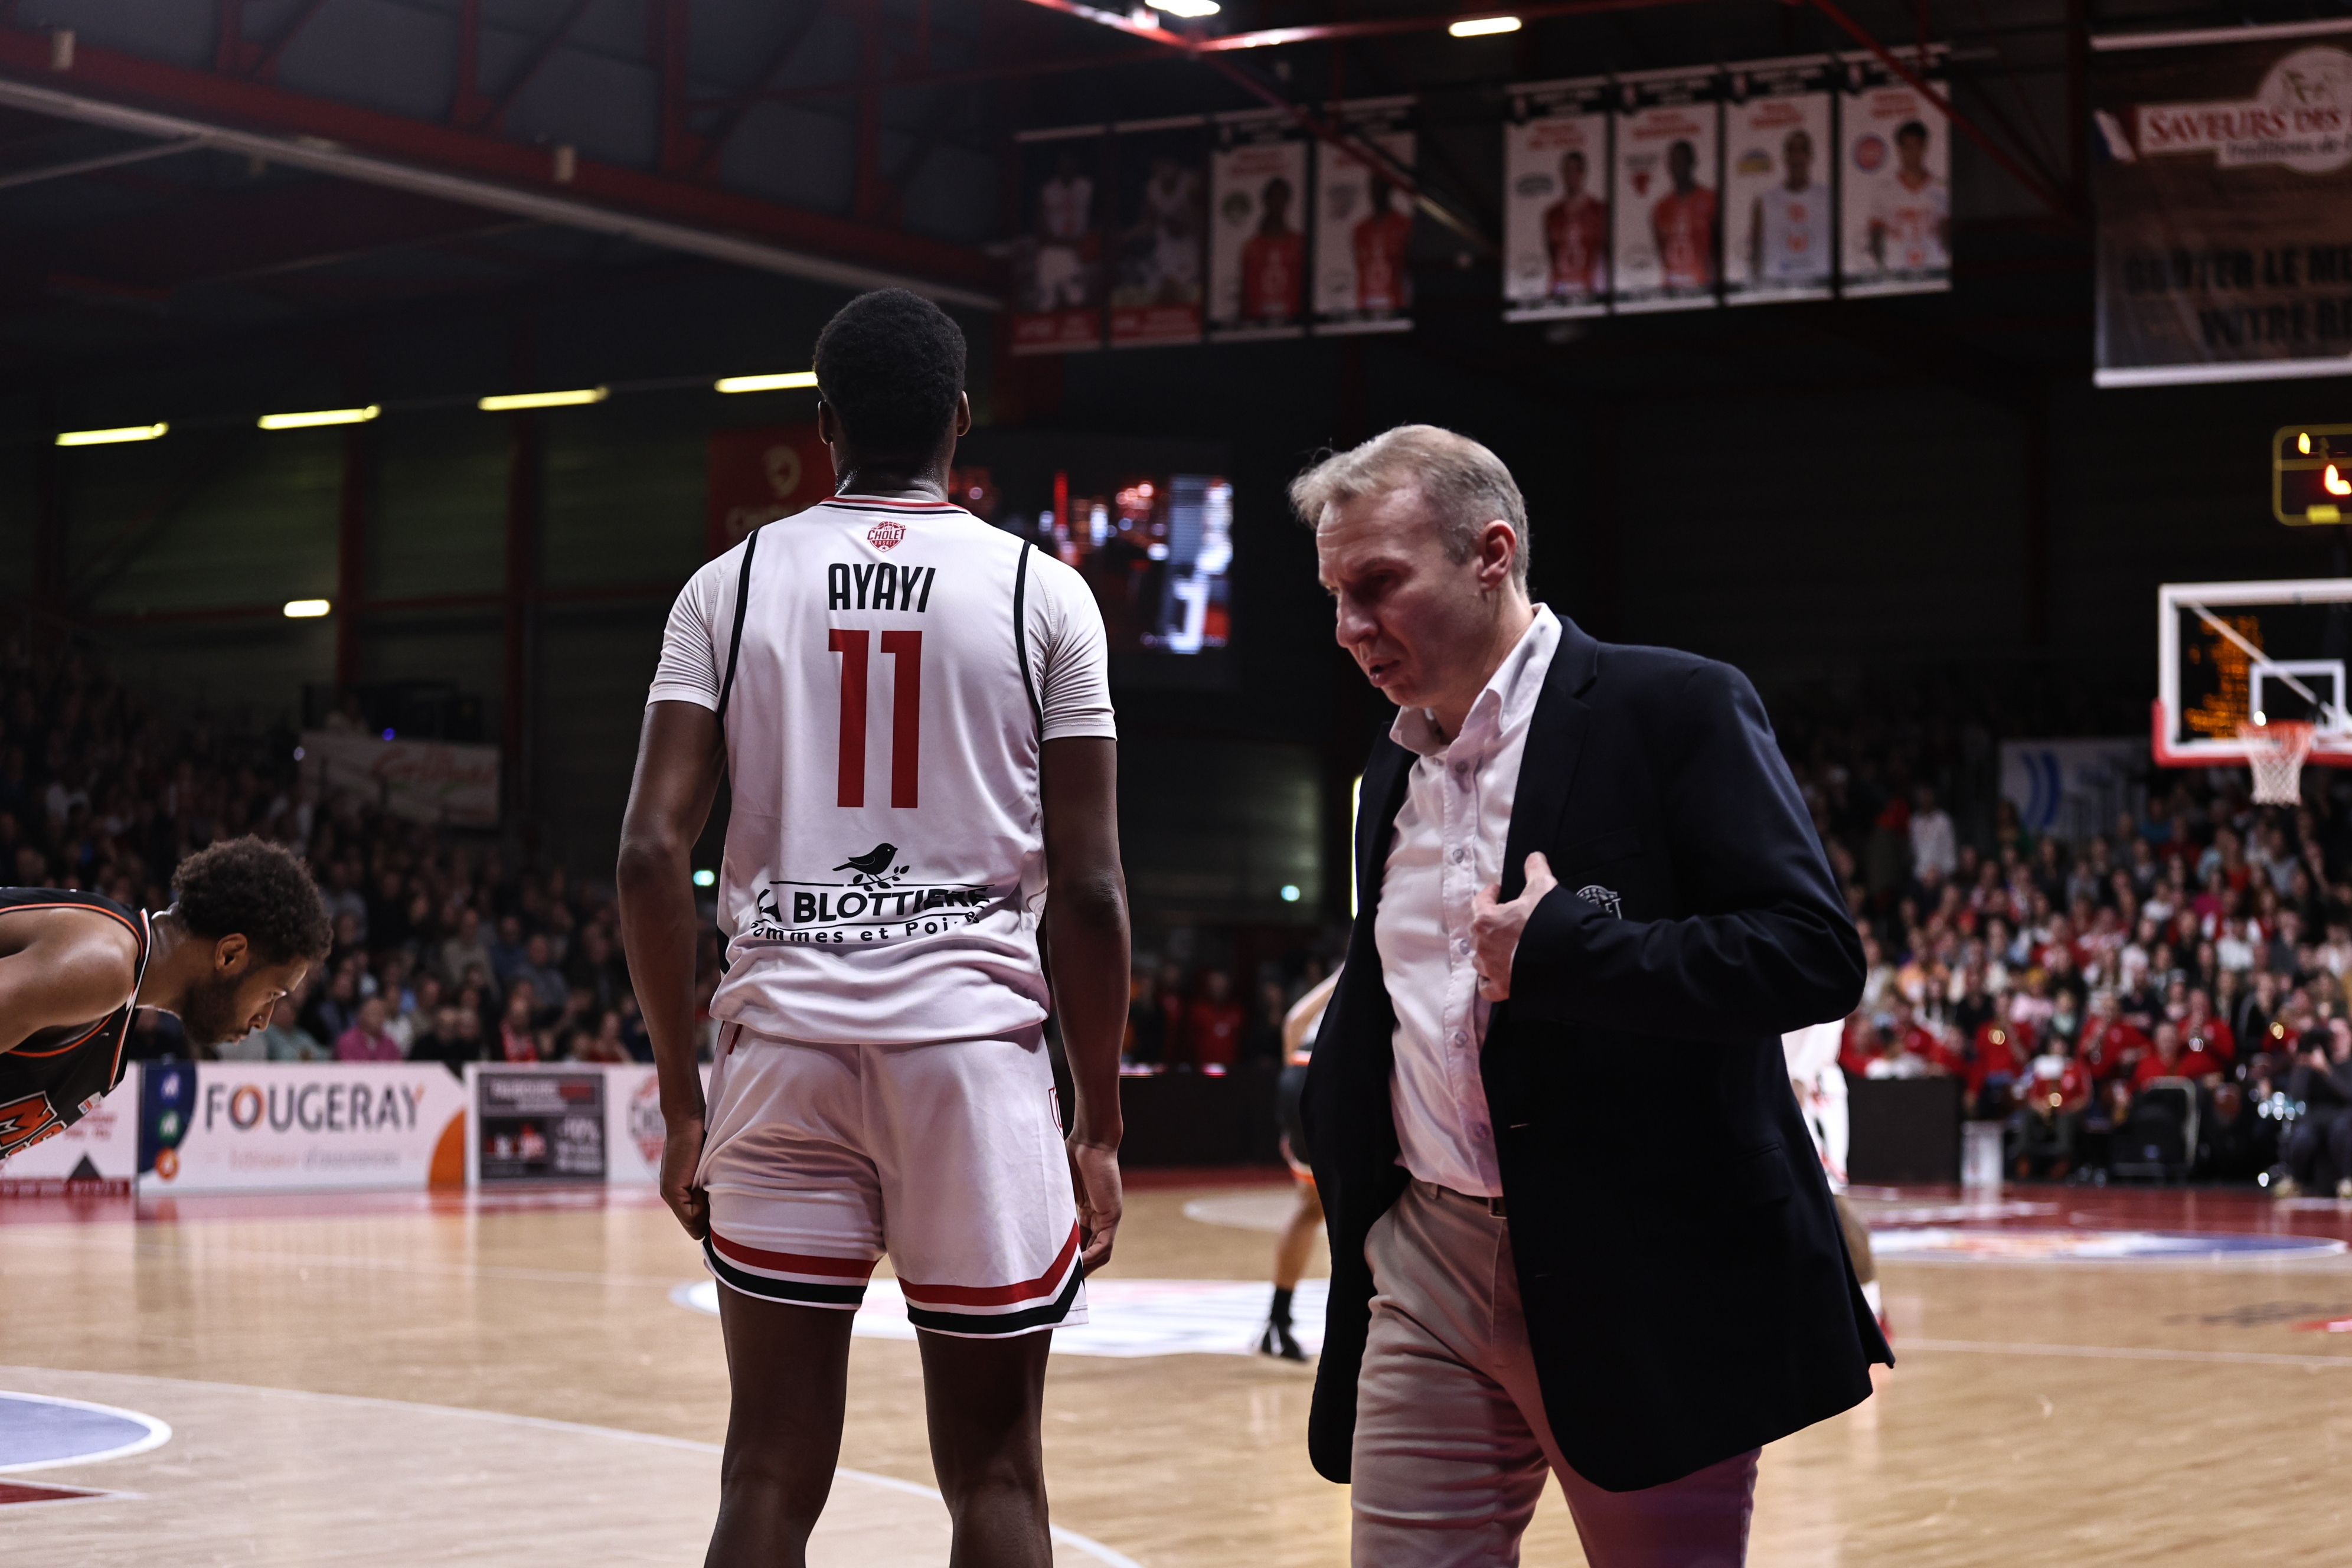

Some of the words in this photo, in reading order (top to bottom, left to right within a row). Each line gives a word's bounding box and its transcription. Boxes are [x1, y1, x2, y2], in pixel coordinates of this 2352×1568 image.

[867, 528, 906, 540] CHOLET
[828, 563, 936, 613] AYAYI
[828, 629, 922, 808] 11
[860, 927, 888, 941] et
[205, 1083, 425, 1133] FOUGERAY
